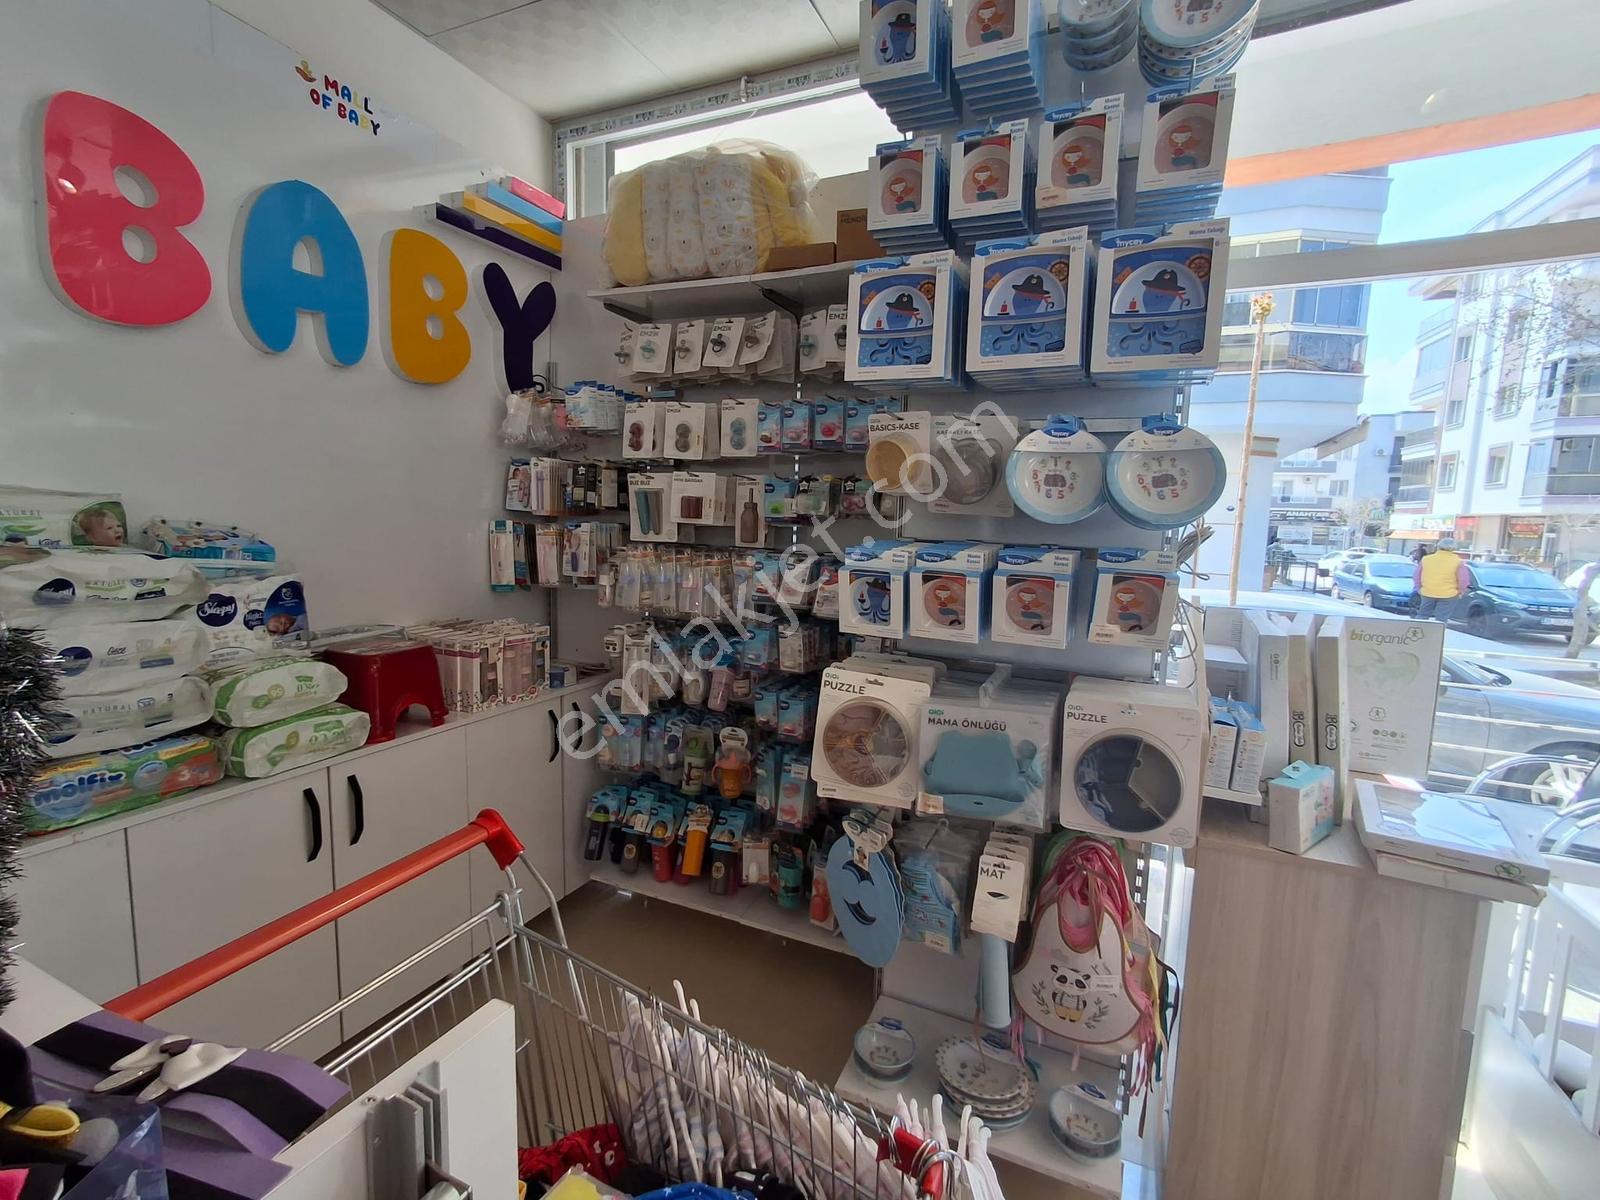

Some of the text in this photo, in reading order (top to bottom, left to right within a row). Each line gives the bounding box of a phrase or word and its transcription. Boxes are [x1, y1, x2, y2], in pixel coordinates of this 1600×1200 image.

[324, 74, 373, 115] MALL
[310, 88, 380, 136] OF BABY
[44, 90, 557, 394] BABY
[870, 422, 920, 432] BASICS-KASE
[199, 602, 235, 616] Sleepy
[1350, 629, 1411, 646] biorganic
[823, 680, 866, 694] PUZZLE
[928, 718, 1007, 732] MAMA ÖNLÜĞÜ
[1066, 712, 1108, 724] PUZZLE
[980, 866, 1006, 880] MAT
